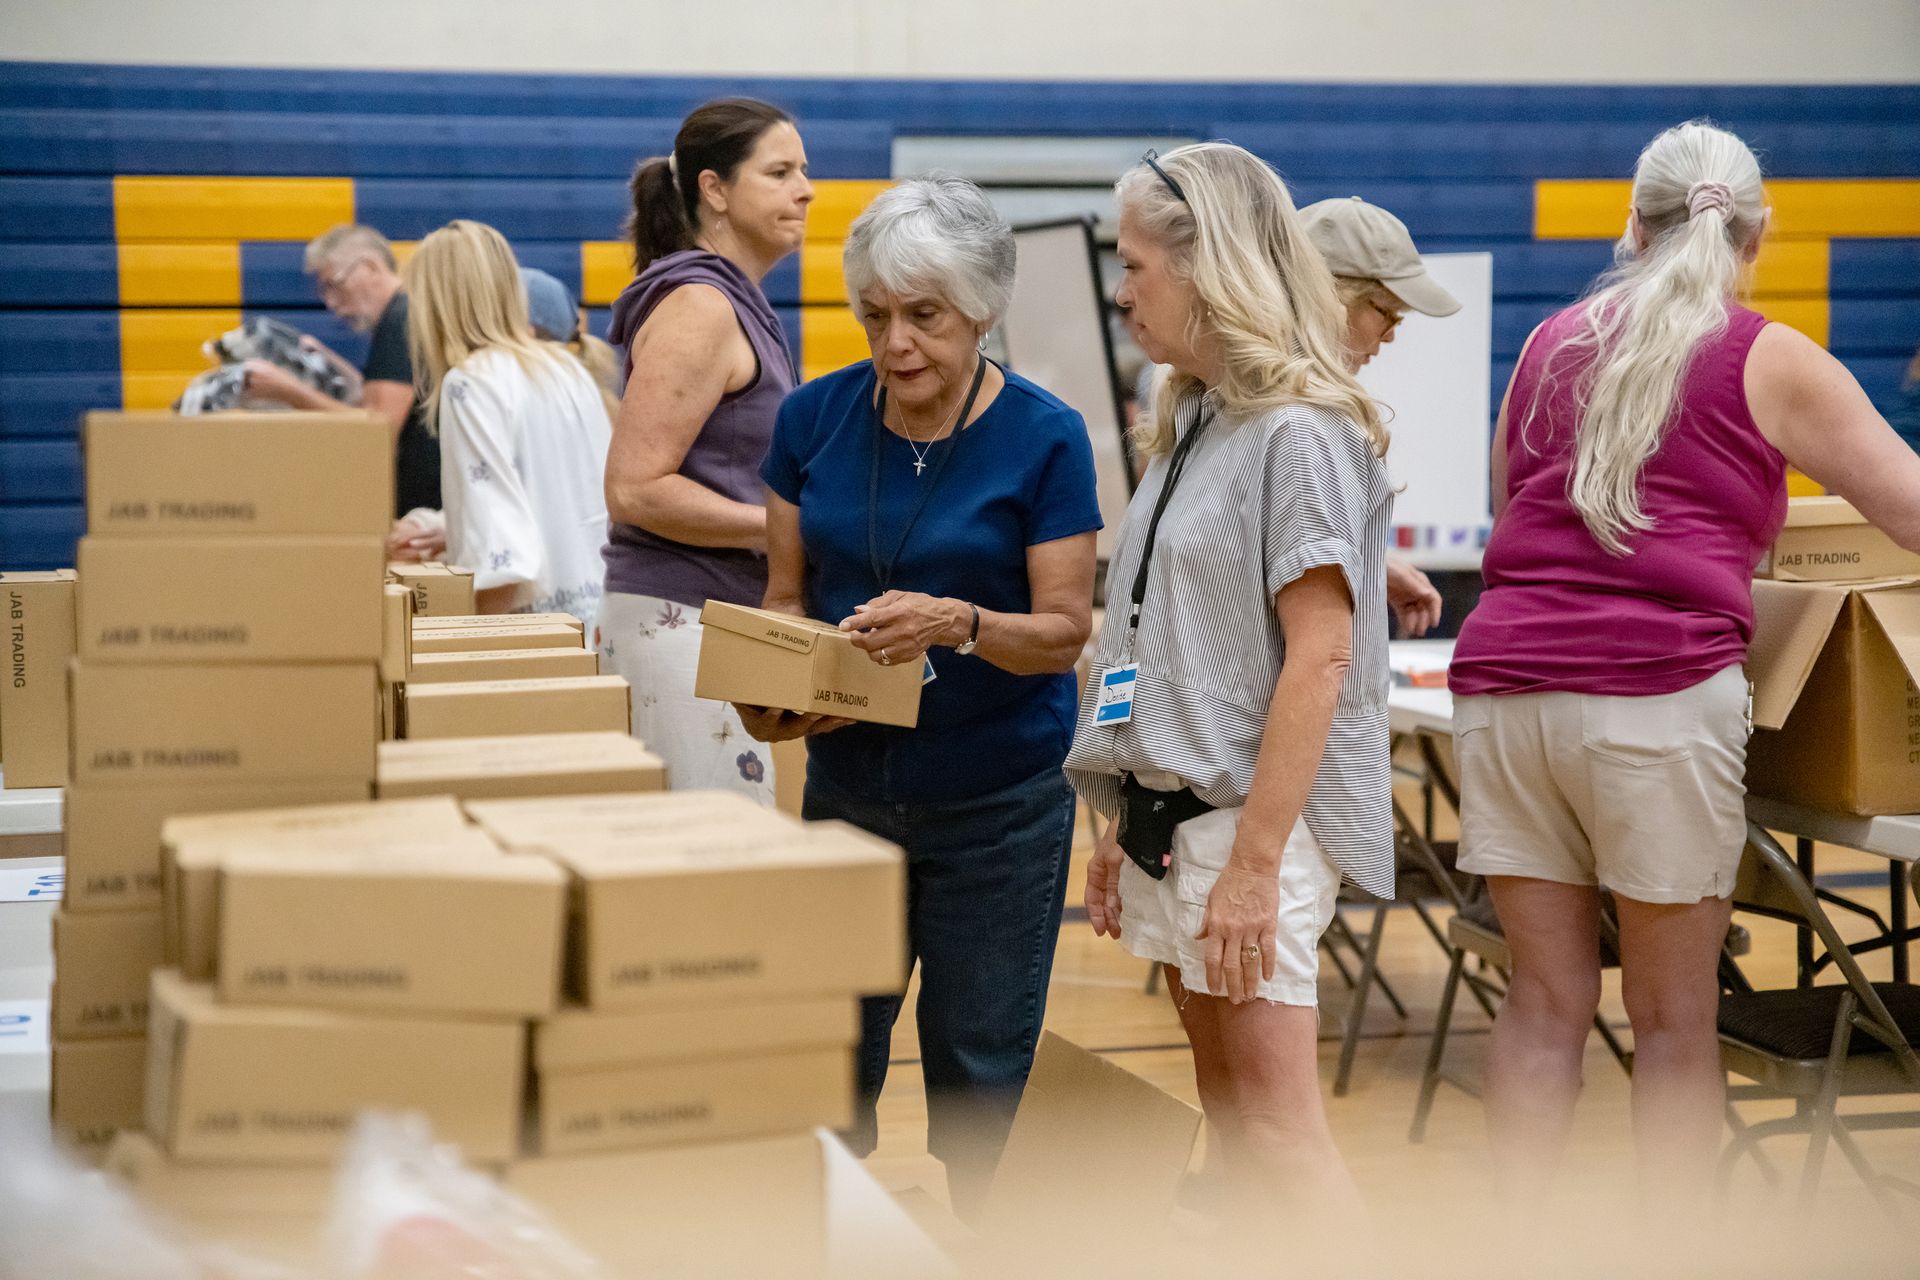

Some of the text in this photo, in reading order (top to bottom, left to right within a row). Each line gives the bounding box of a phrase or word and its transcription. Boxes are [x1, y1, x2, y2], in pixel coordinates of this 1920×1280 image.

[1778, 554, 1803, 566] JAB
[1806, 552, 1861, 565] TRADING
[416, 582, 428, 611] JAB
[10, 591, 26, 688] JAB TRADING
[766, 629, 810, 648] JAB TRADING
[814, 689, 869, 708] JAB TRADING
